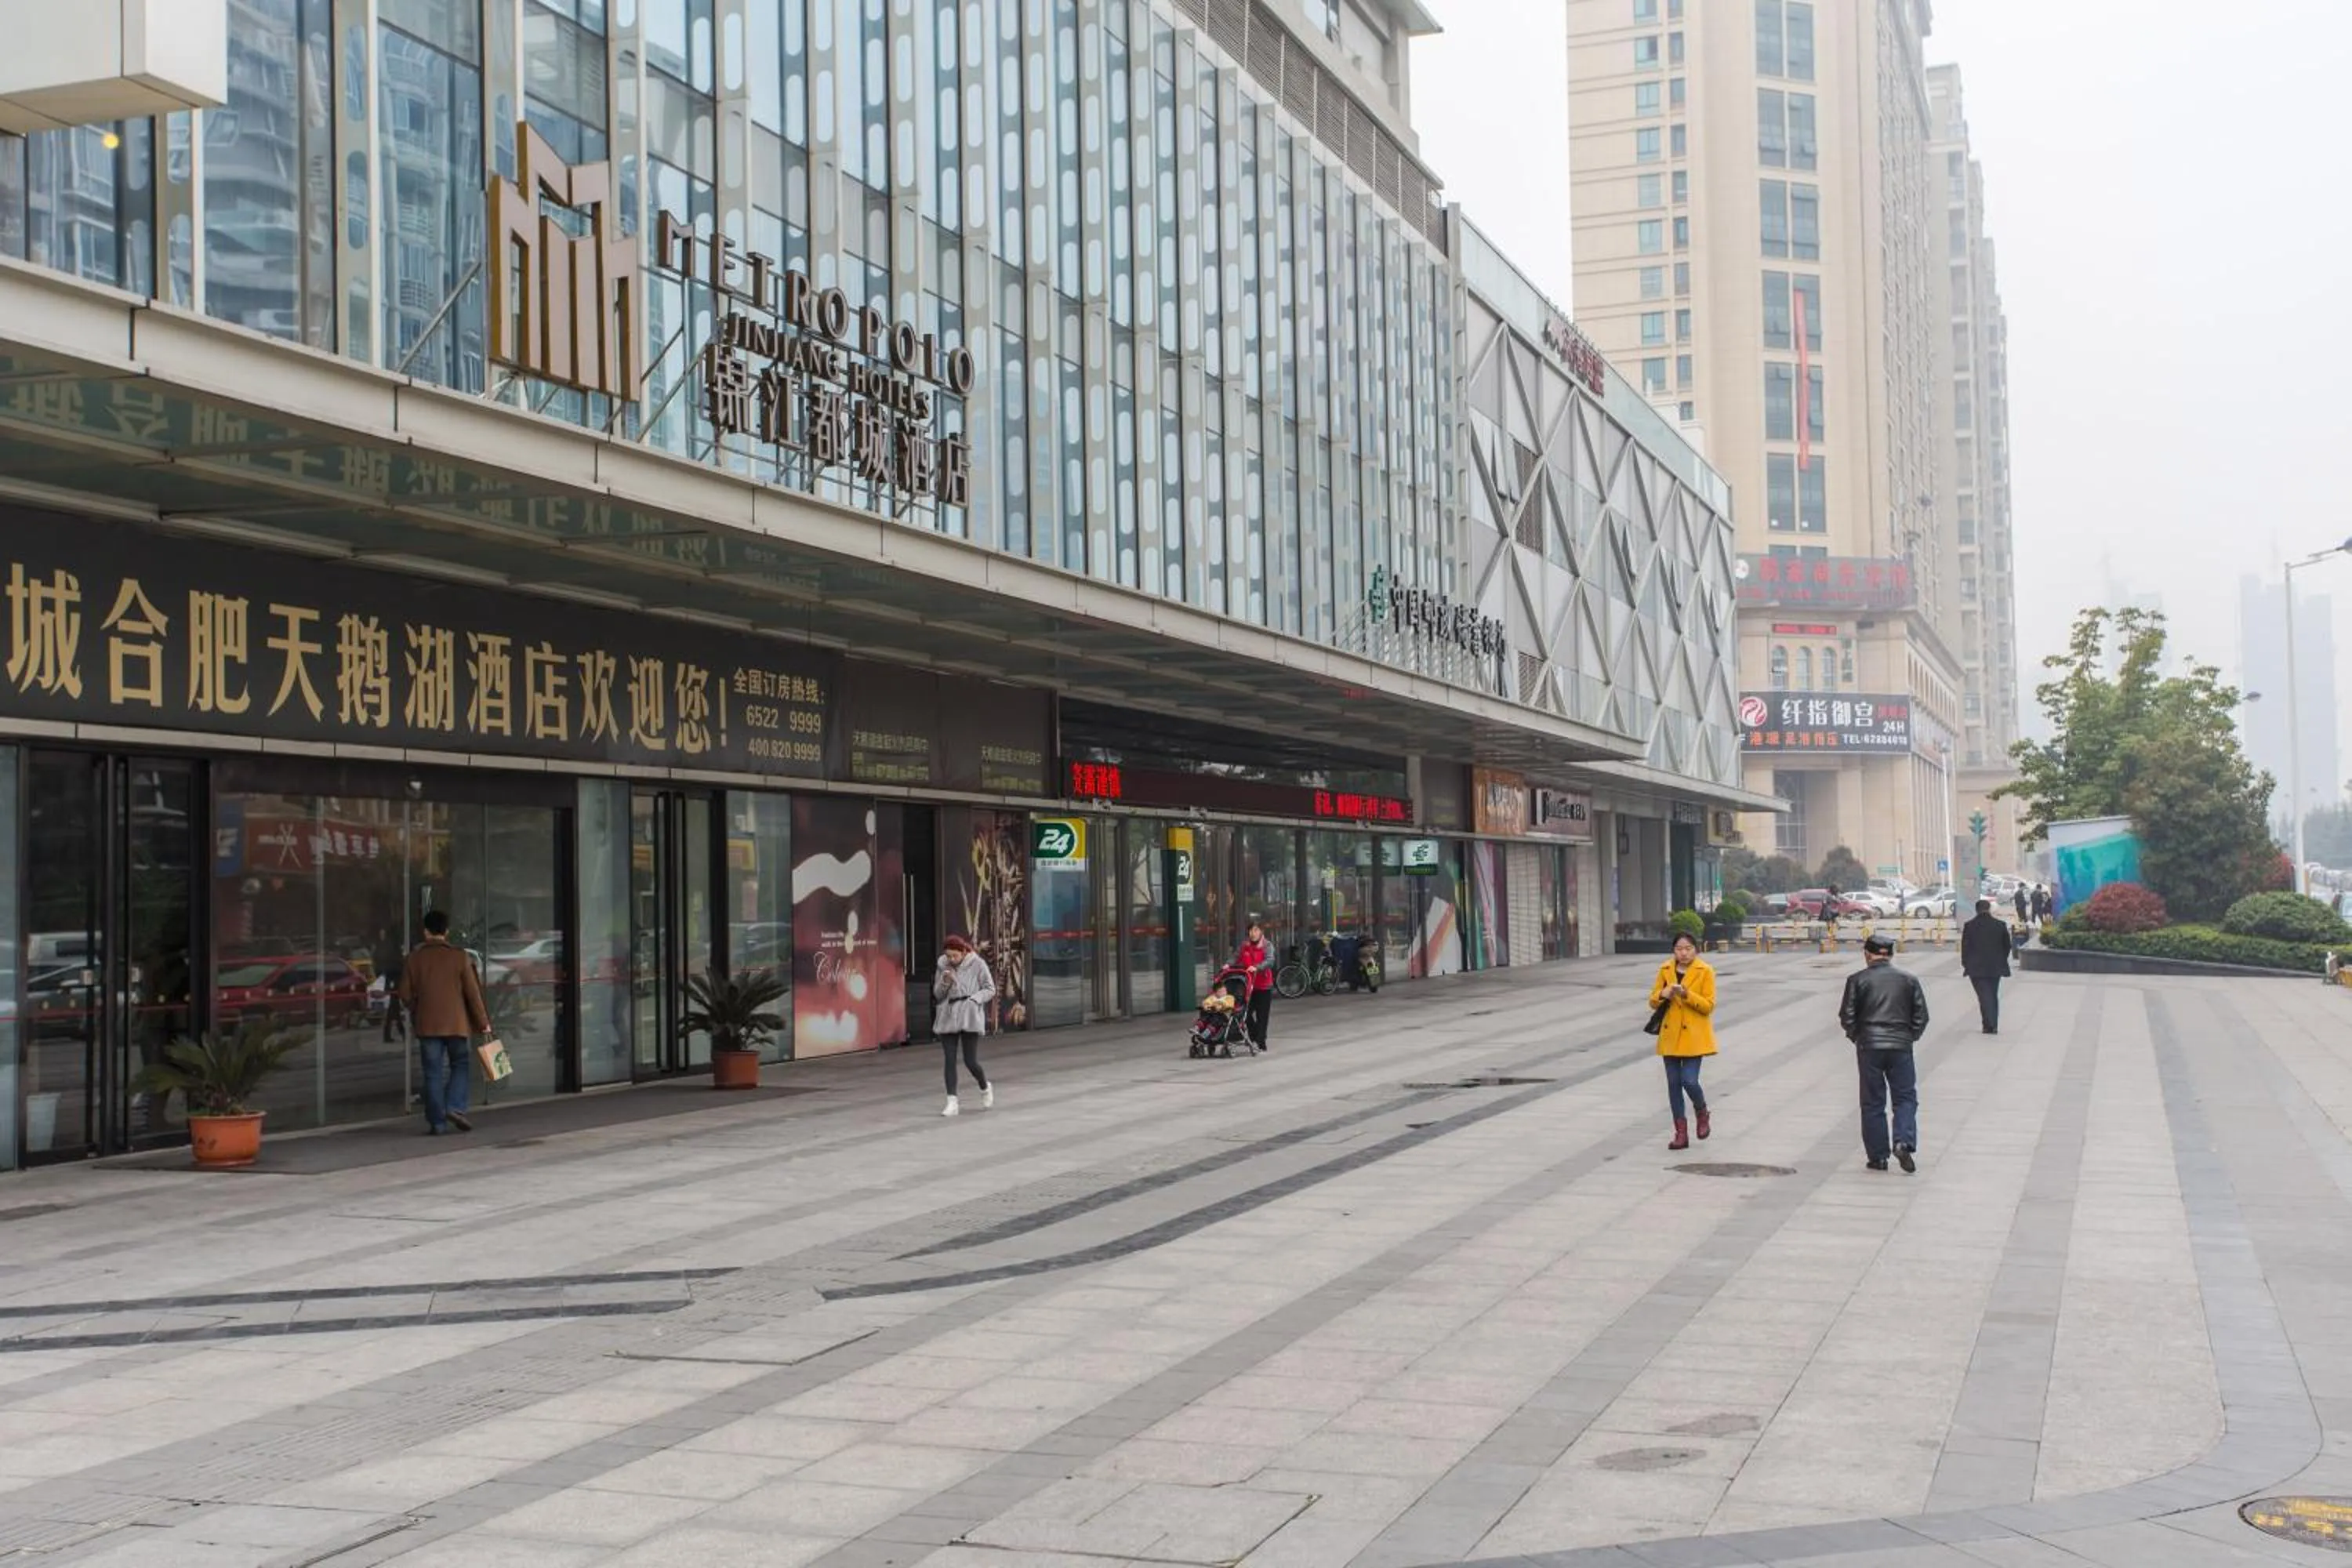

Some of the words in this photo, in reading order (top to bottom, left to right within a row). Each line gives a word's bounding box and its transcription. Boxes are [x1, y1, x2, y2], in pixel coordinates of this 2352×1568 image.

[658, 209, 975, 394] METROPOLO
[726, 314, 840, 383] JINJIANG
[848, 362, 930, 419] HOTELS
[706, 343, 971, 508] 锦江都城酒店
[746, 703, 779, 729] 6522
[789, 711, 821, 735] 9999
[1781, 699, 1873, 728] 纤指御宫
[1882, 720, 1905, 734] 24H
[1039, 828, 1070, 854] 24
